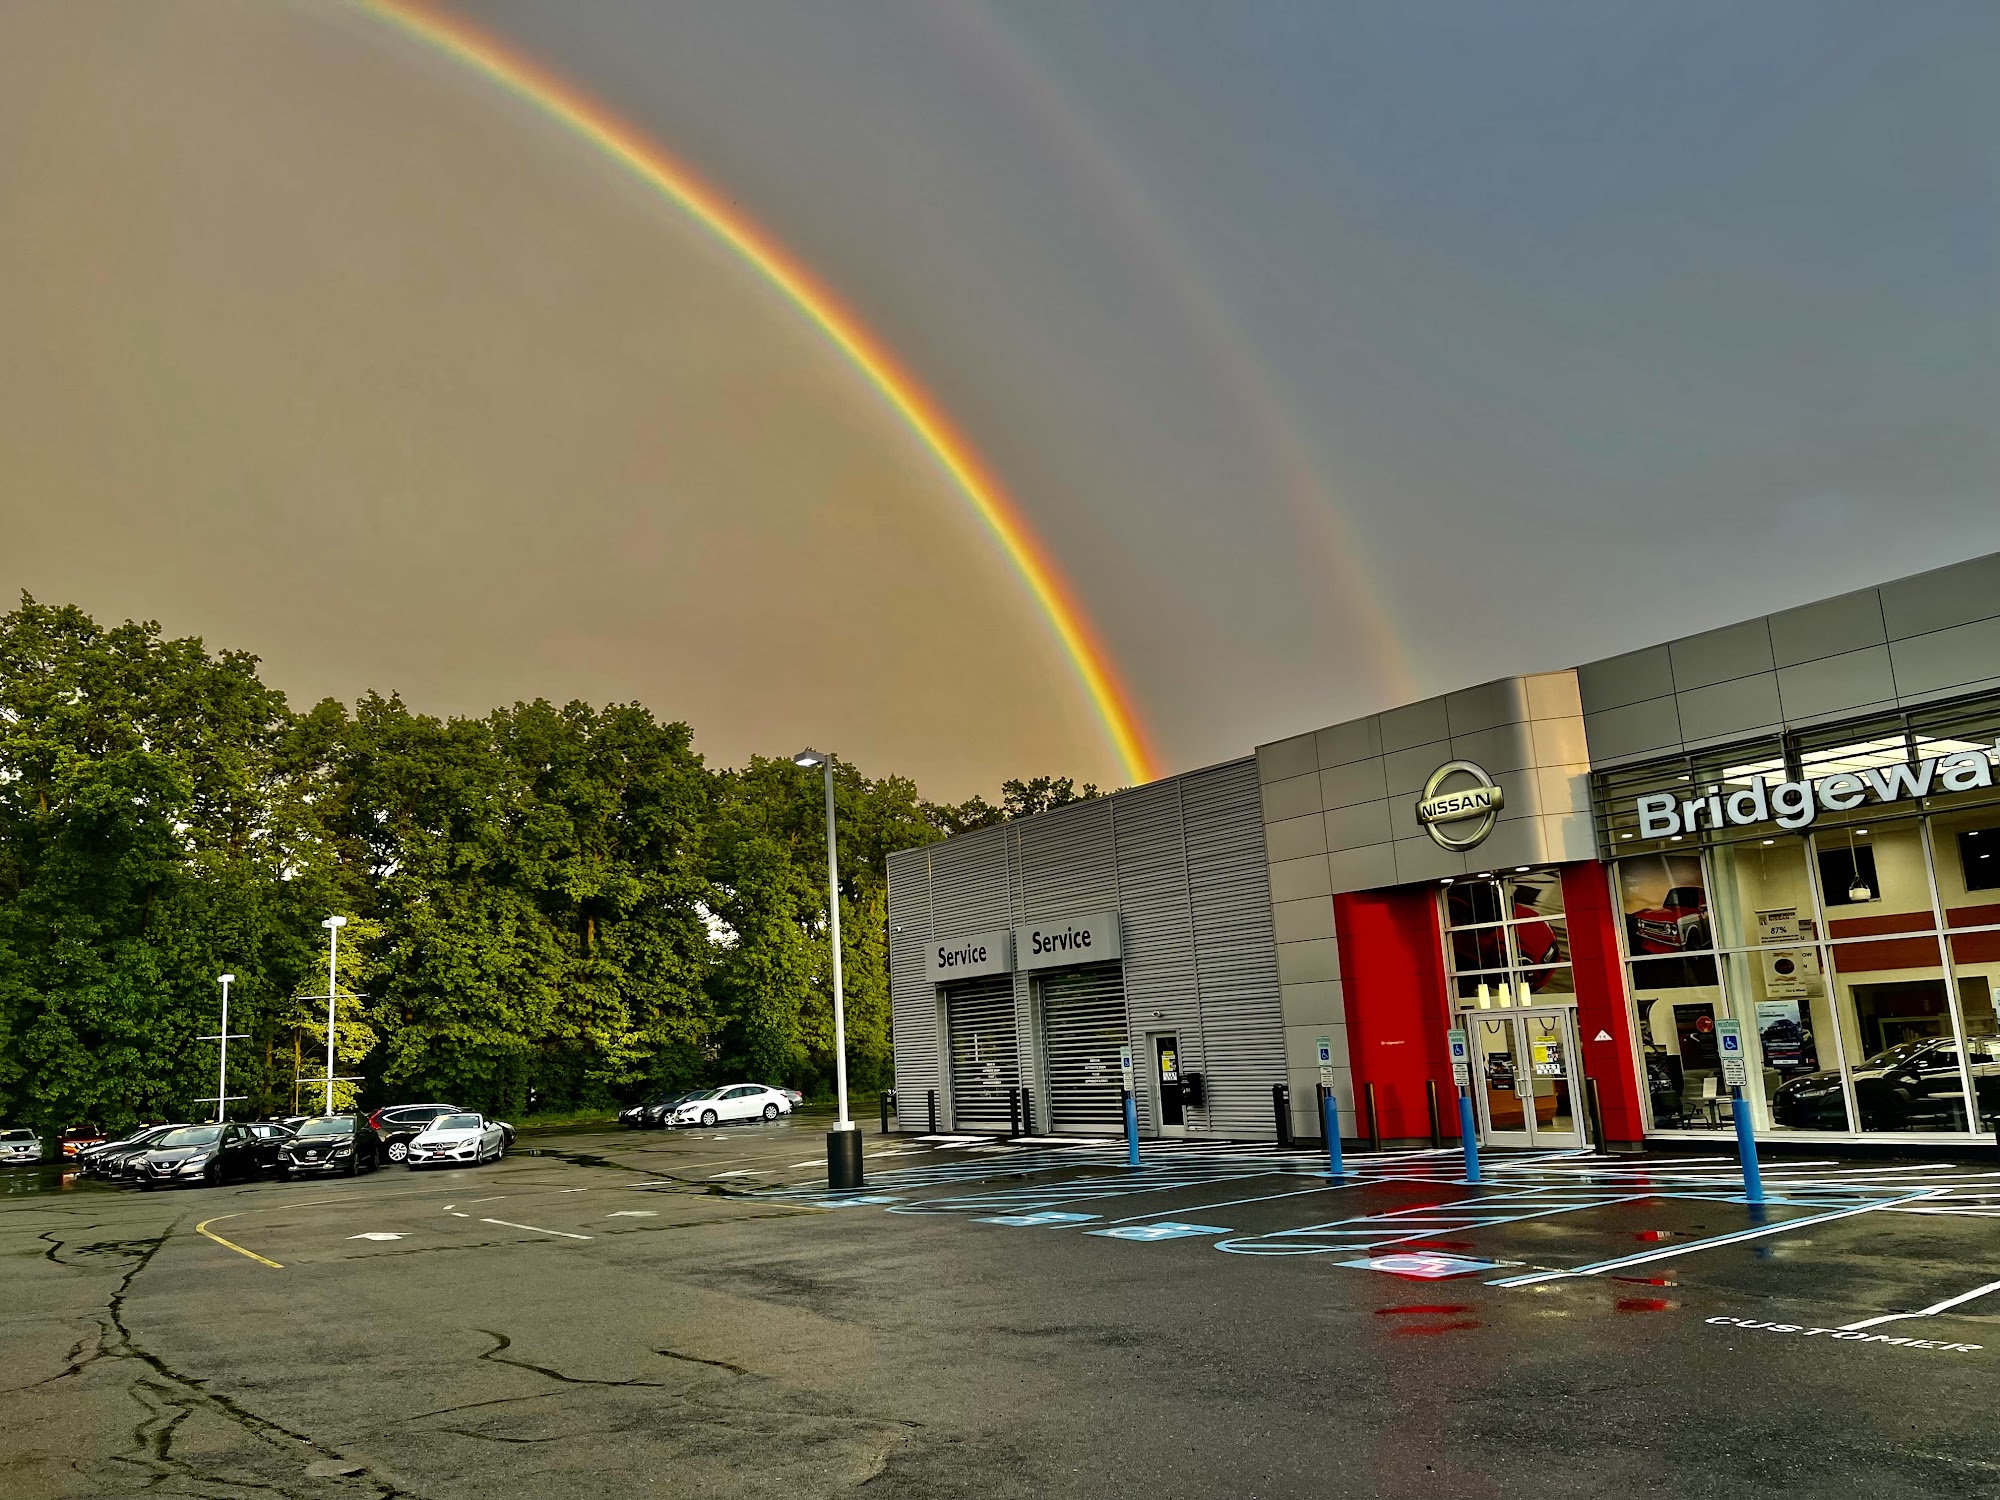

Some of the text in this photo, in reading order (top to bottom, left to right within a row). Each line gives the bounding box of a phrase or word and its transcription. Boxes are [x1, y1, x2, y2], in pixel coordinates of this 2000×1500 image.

[1421, 791, 1492, 819] NISSAN
[1032, 926, 1092, 955] Service
[937, 943, 987, 968] Service
[1704, 1316, 1984, 1353] CUSTOMER
